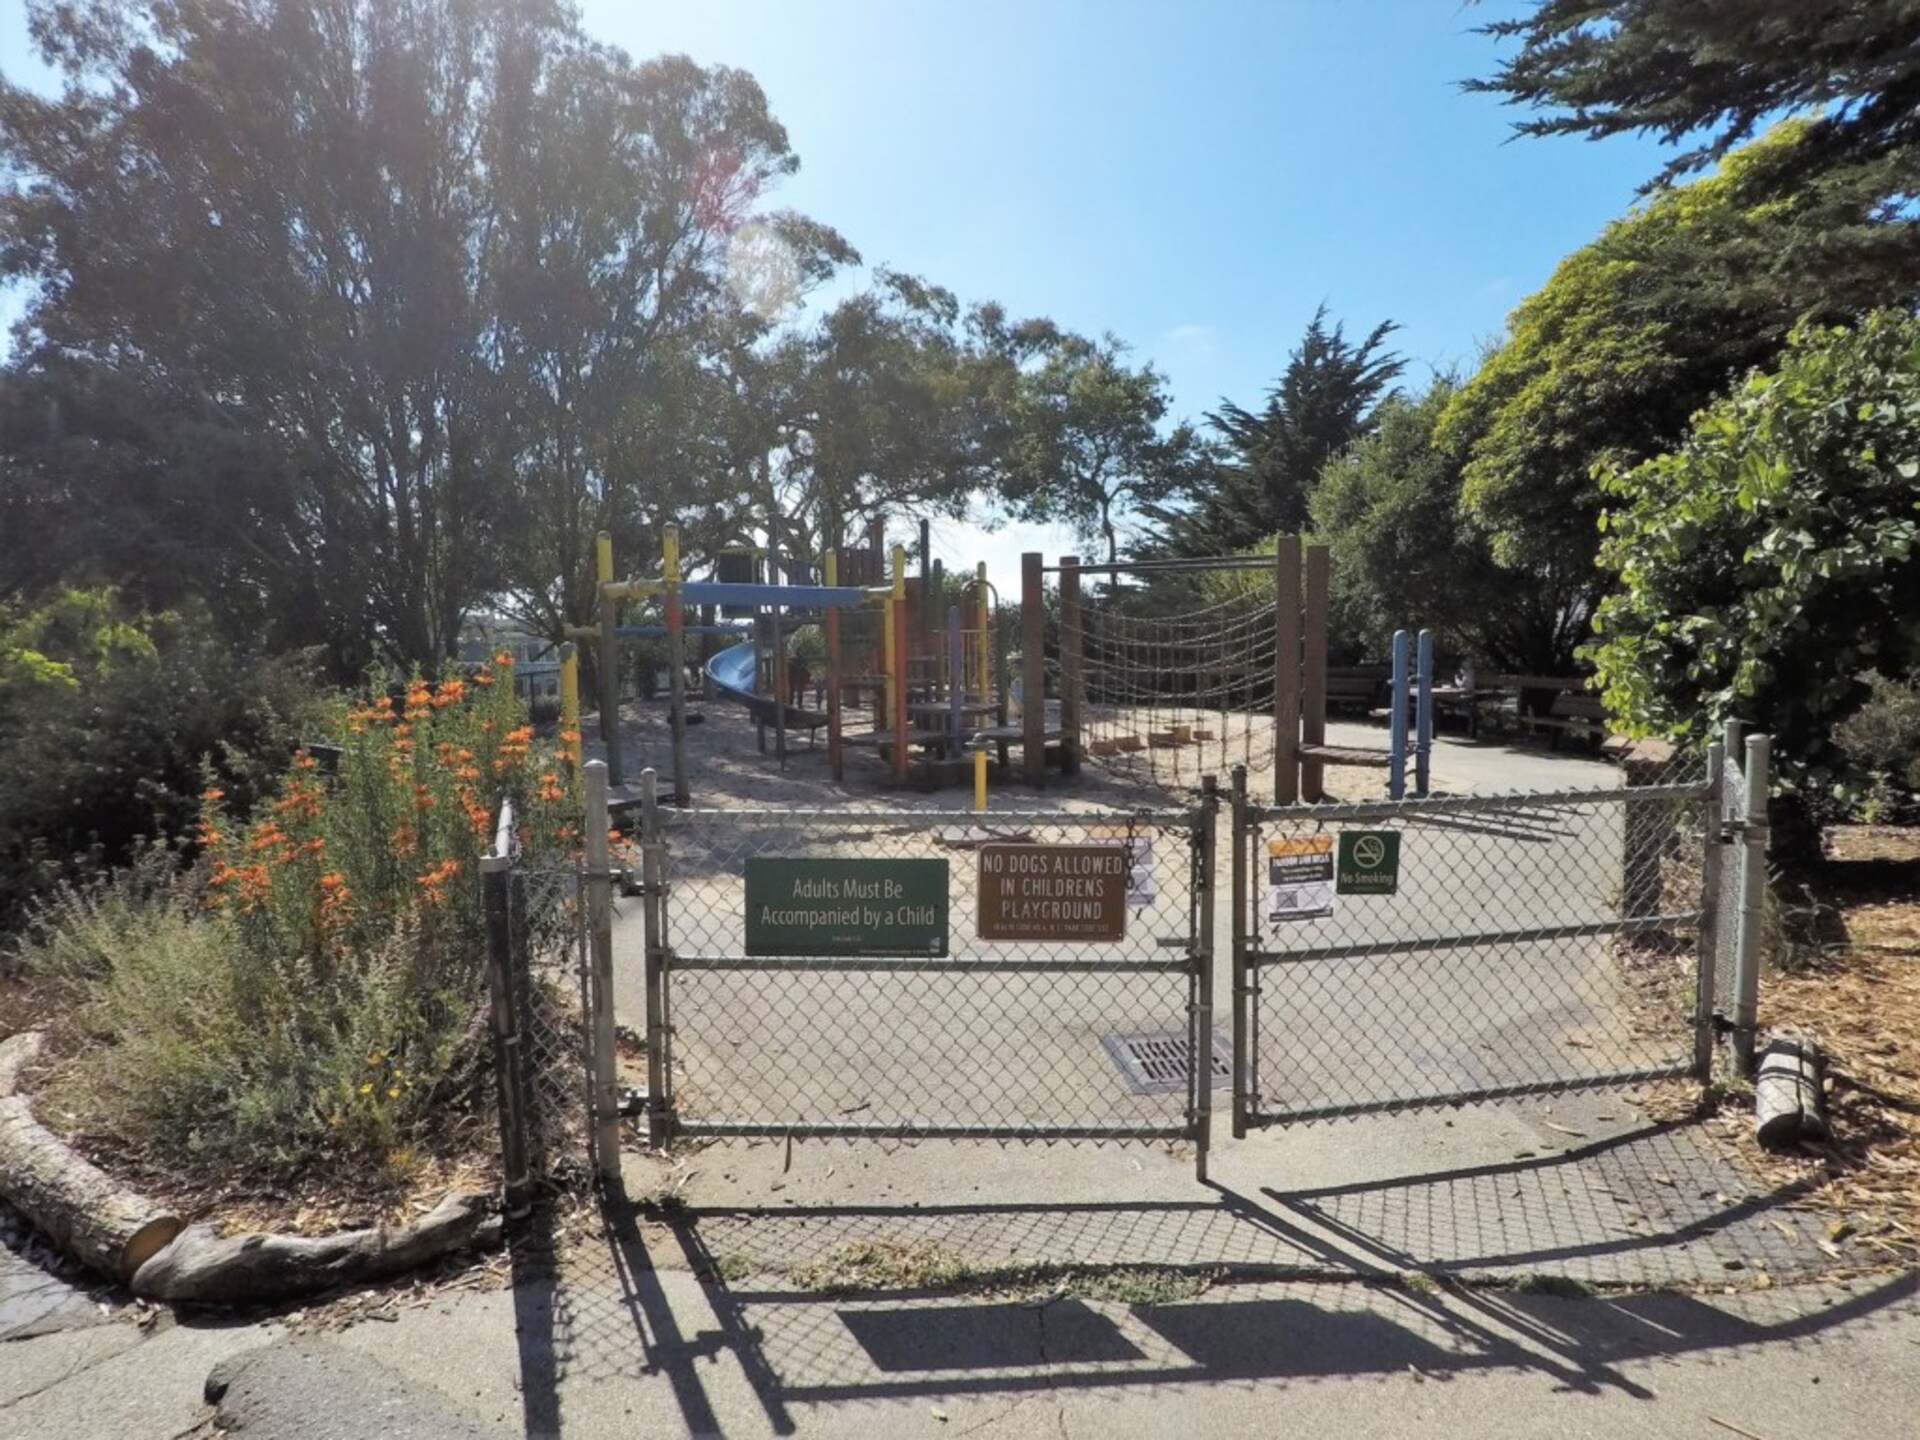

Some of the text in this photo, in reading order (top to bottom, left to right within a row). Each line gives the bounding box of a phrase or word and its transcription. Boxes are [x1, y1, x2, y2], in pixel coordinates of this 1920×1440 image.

[983, 854, 1122, 875] NO DOGS ALLOWED
[792, 878, 903, 899] Adults Must Be
[1001, 878, 1015, 896] IN
[1355, 872, 1394, 886] Smoking
[760, 905, 935, 930] Accompanied by a Child
[1002, 901, 1102, 920] PLAYGROUND
